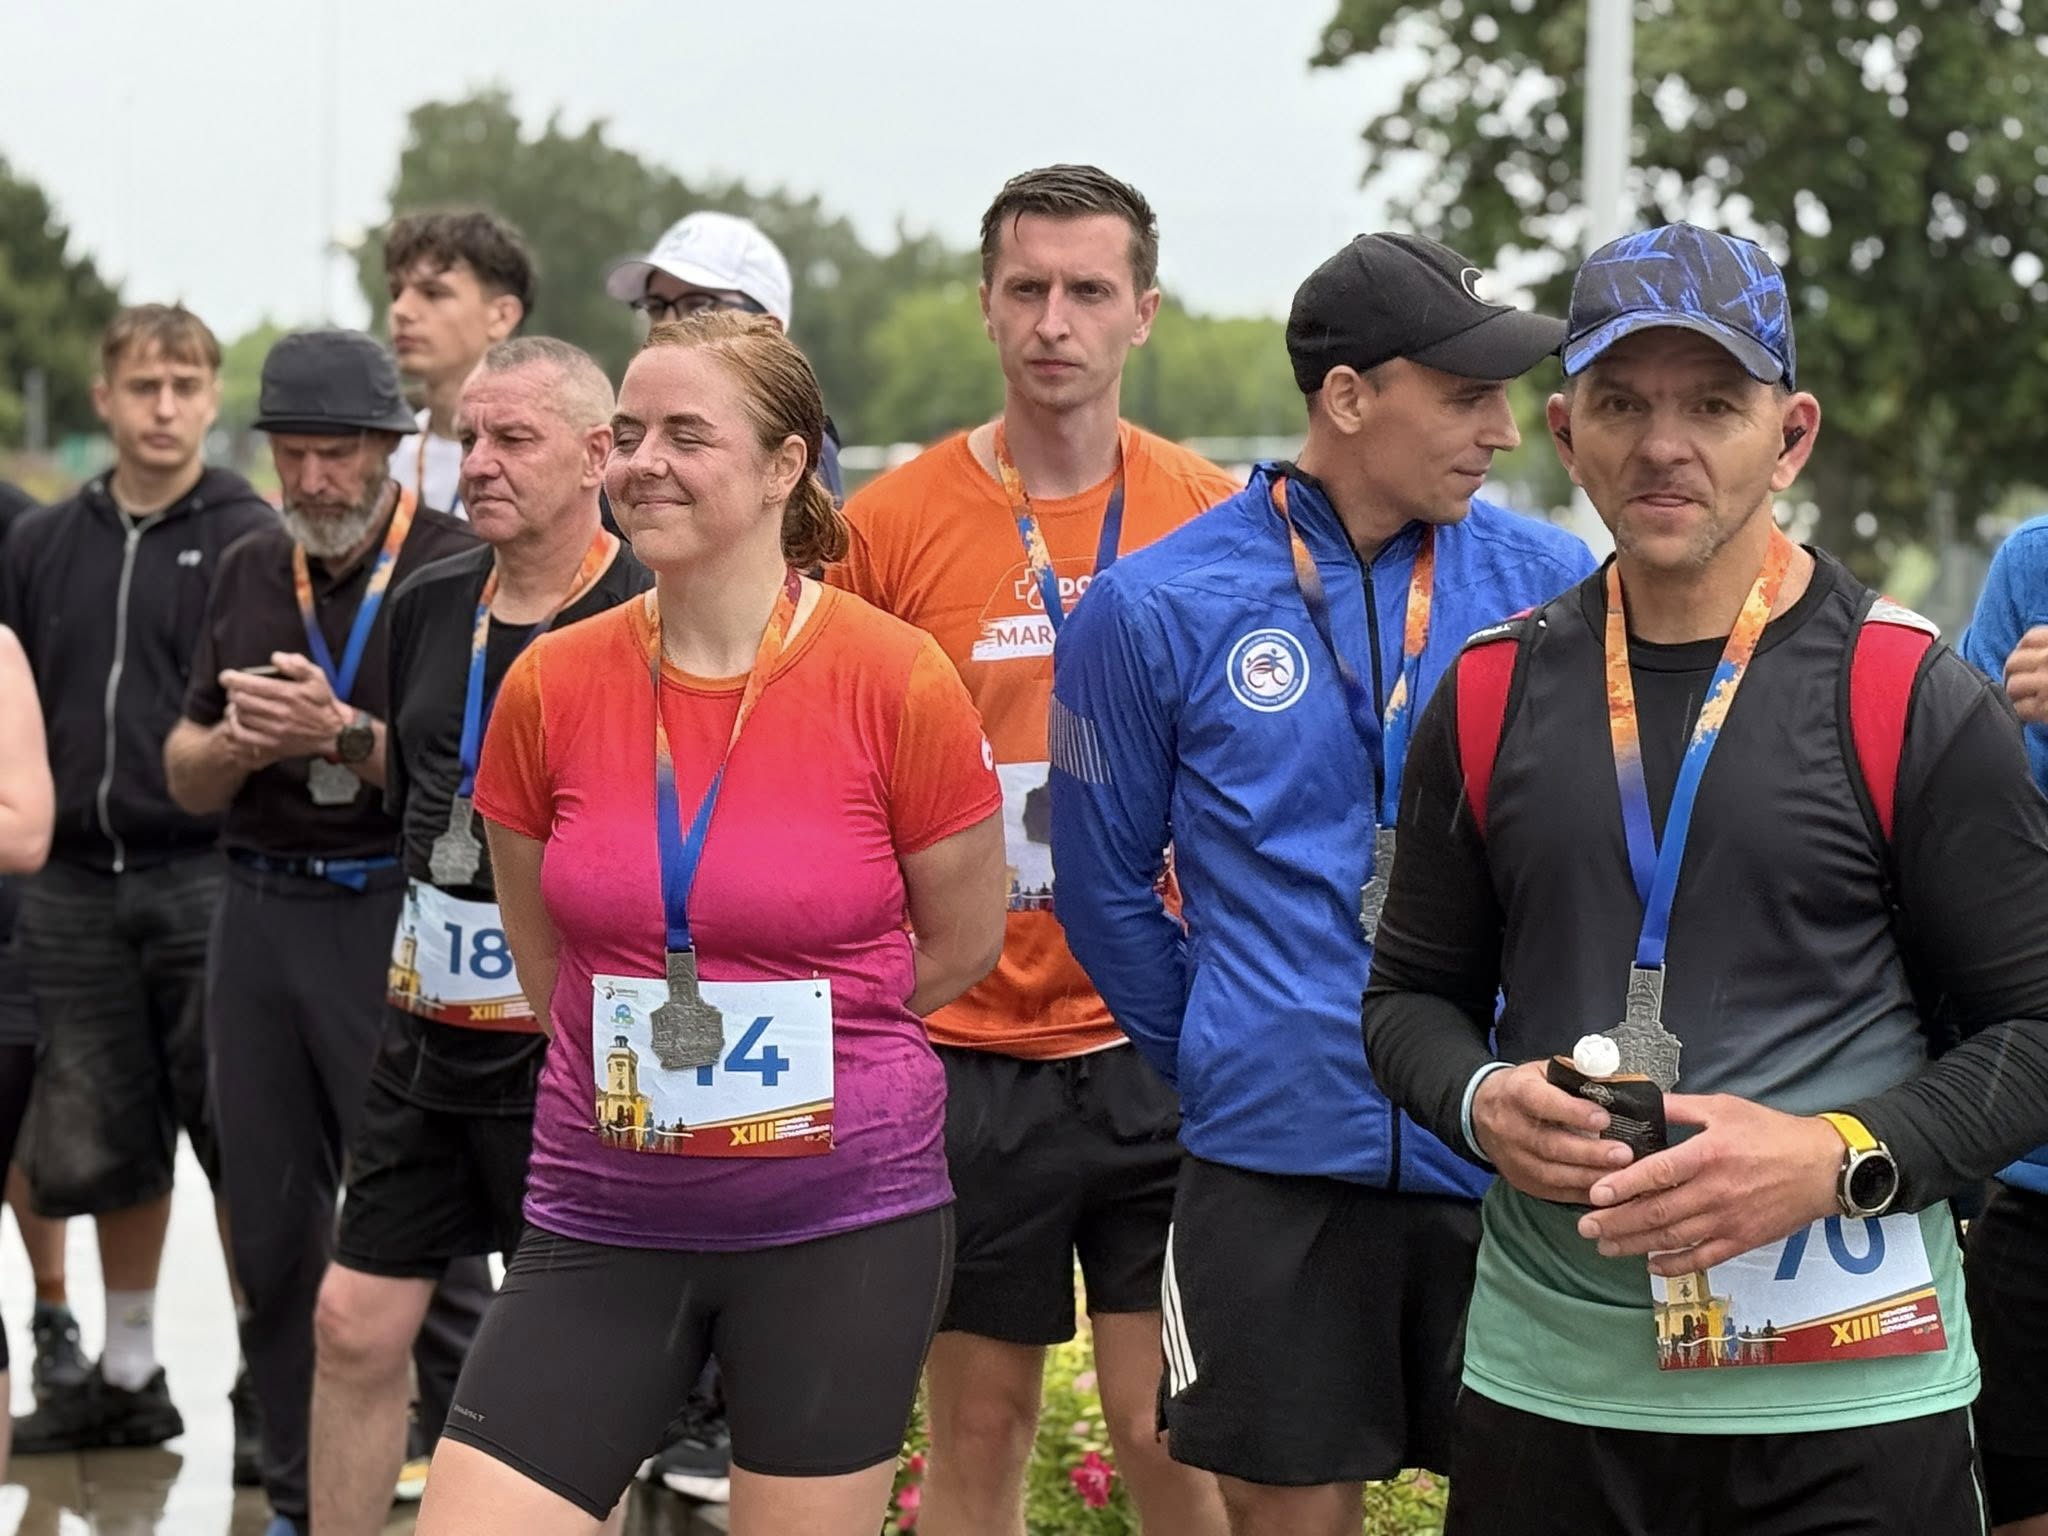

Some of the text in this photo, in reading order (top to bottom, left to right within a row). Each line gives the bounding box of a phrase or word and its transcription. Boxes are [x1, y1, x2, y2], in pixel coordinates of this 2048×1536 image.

[444, 921, 513, 980] 18
[469, 1003, 504, 1021] XIII
[696, 1016, 789, 1086] 4
[729, 1121, 774, 1147] XIII
[1830, 1310, 1882, 1348] XIII
